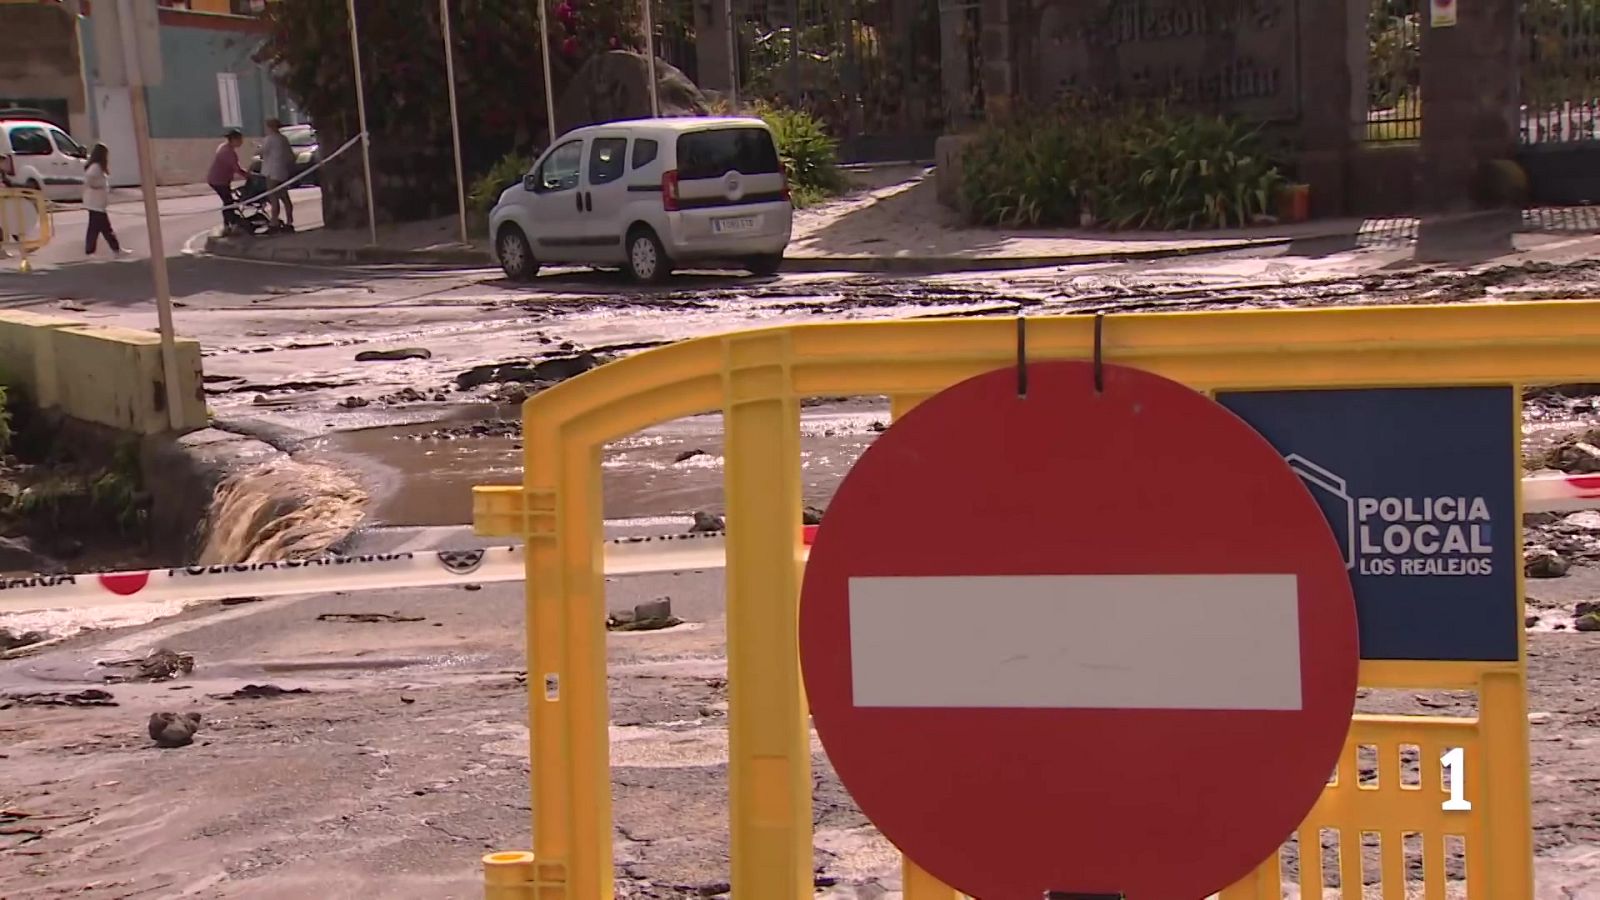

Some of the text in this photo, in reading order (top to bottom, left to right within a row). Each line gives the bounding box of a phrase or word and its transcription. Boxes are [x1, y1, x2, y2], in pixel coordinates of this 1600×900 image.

[1357, 496, 1491, 522] POLICIA
[1359, 524, 1493, 555] LOCAL
[1359, 558, 1493, 576] LOS REALEJOS
